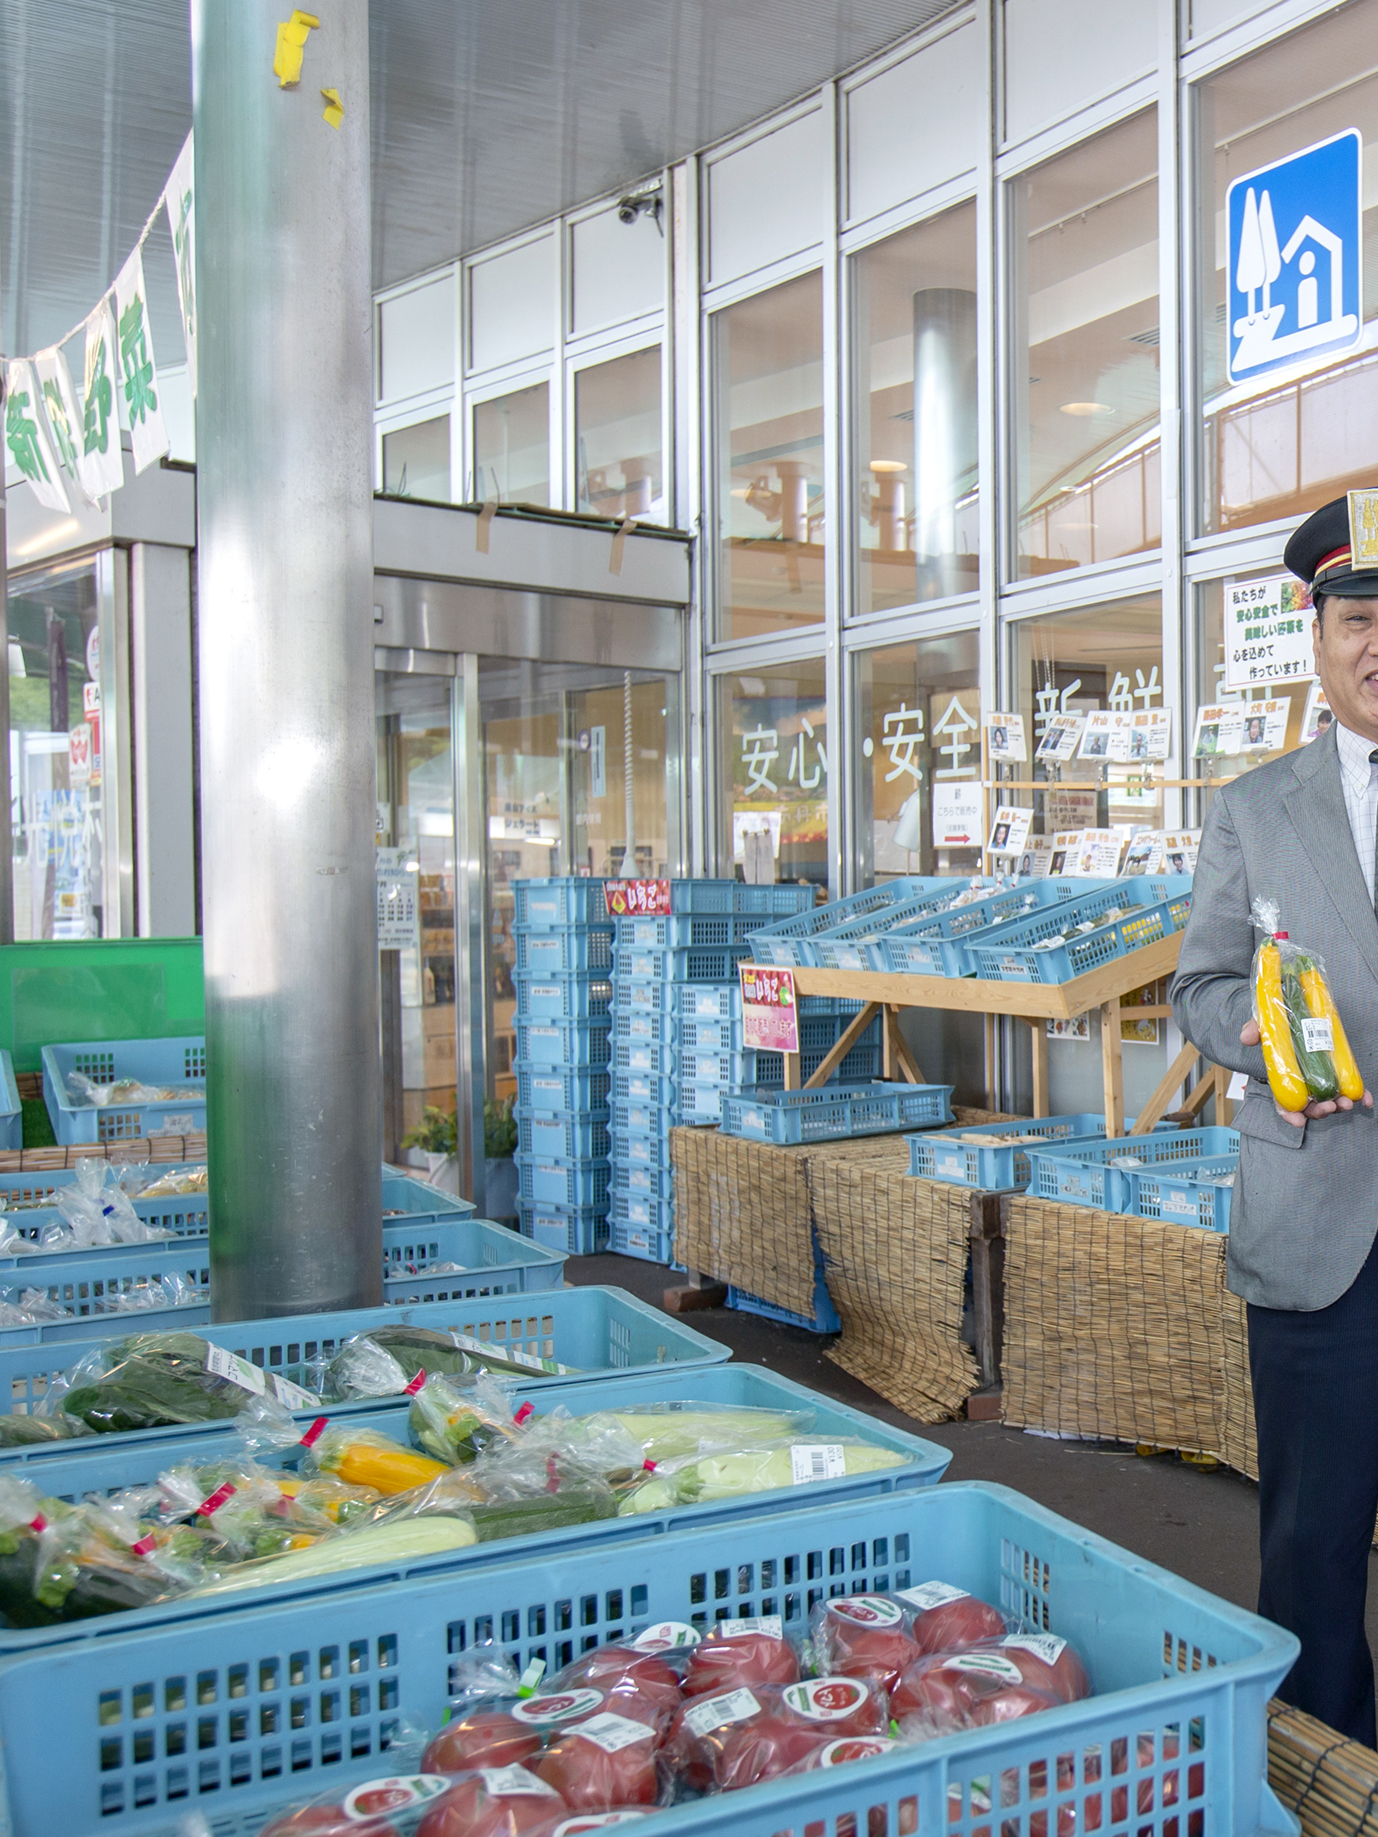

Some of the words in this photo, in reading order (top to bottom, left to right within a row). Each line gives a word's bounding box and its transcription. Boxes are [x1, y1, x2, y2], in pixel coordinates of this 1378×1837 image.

[1232, 585, 1266, 605] 私たちが
[1236, 603, 1278, 623] 安心安全で
[1233, 644, 1274, 662] 心を込めて
[1249, 659, 1307, 679] 作っています!
